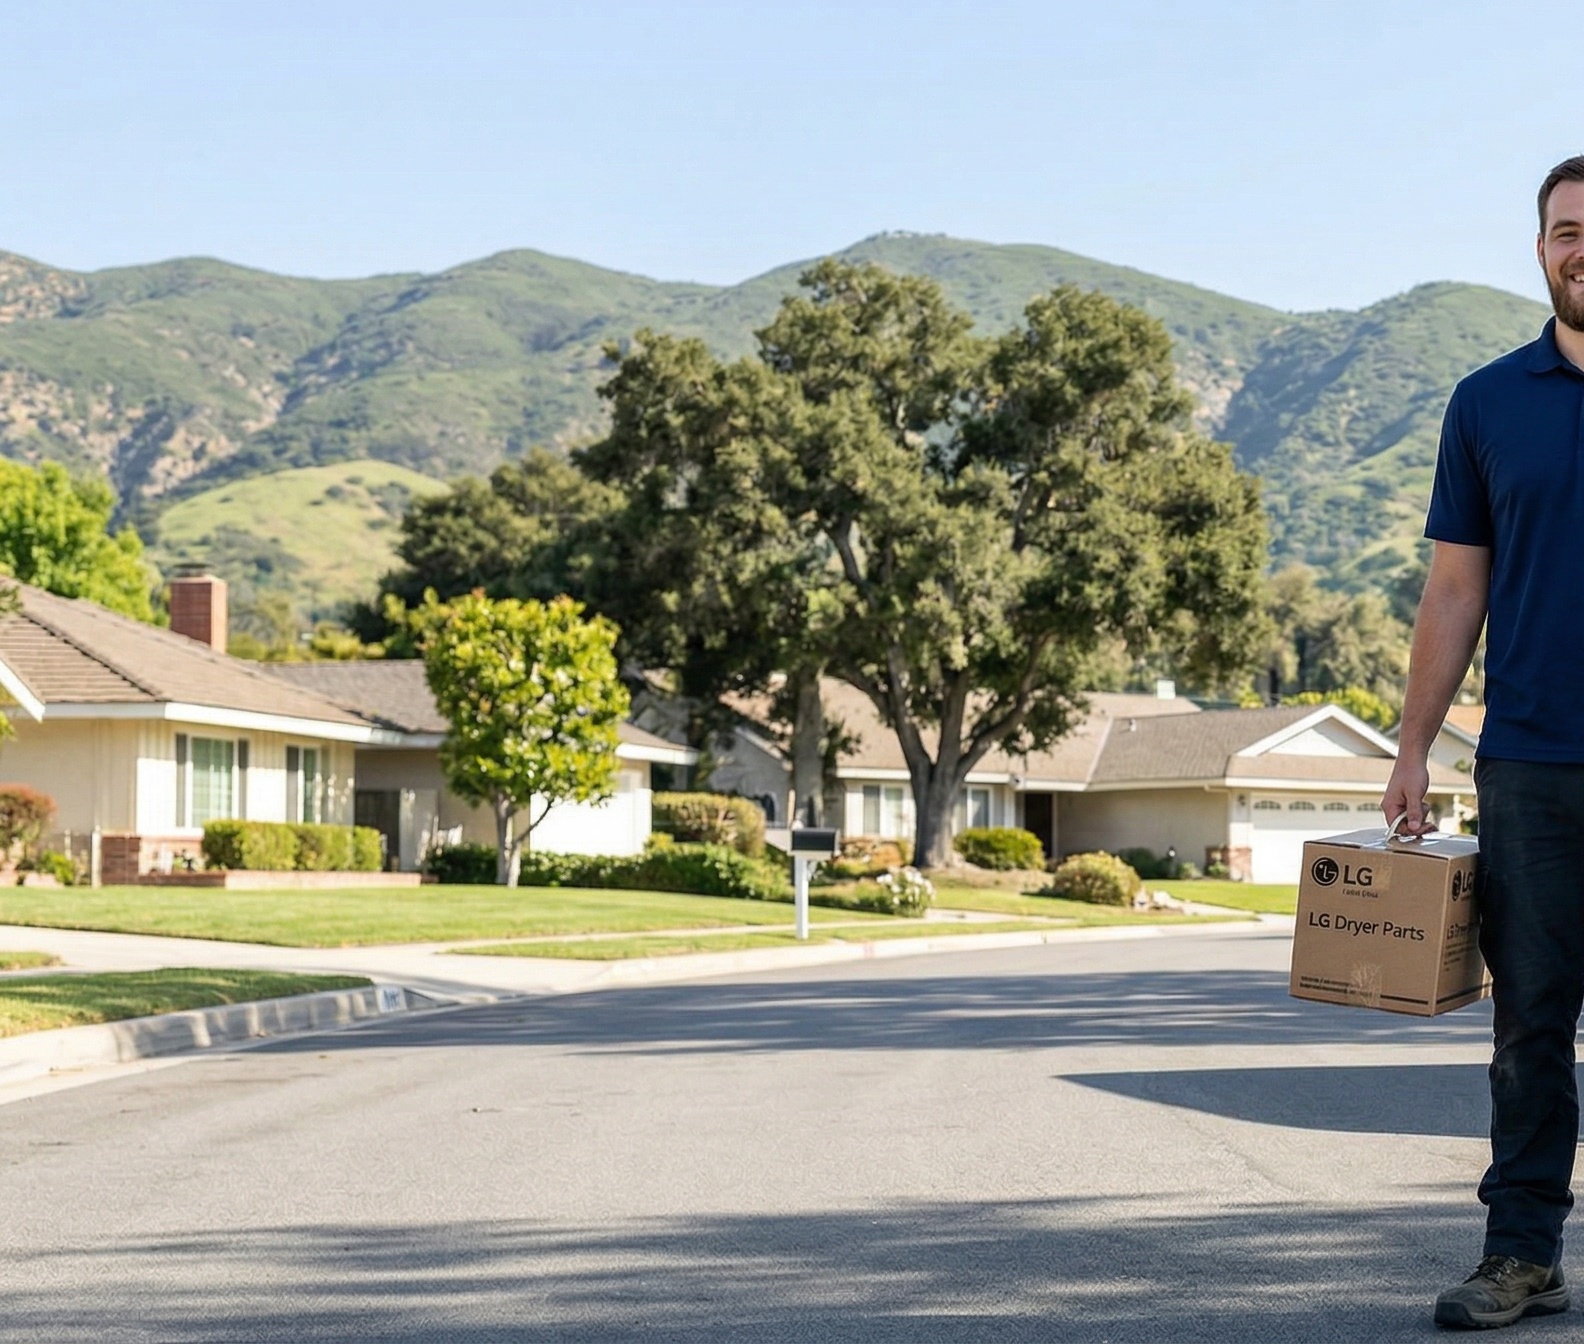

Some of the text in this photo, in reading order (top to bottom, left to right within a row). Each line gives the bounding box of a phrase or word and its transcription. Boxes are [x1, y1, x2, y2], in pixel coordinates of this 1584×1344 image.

[1343, 865, 1373, 887] LG
[1309, 912, 1425, 941] LG Dryer Parts
